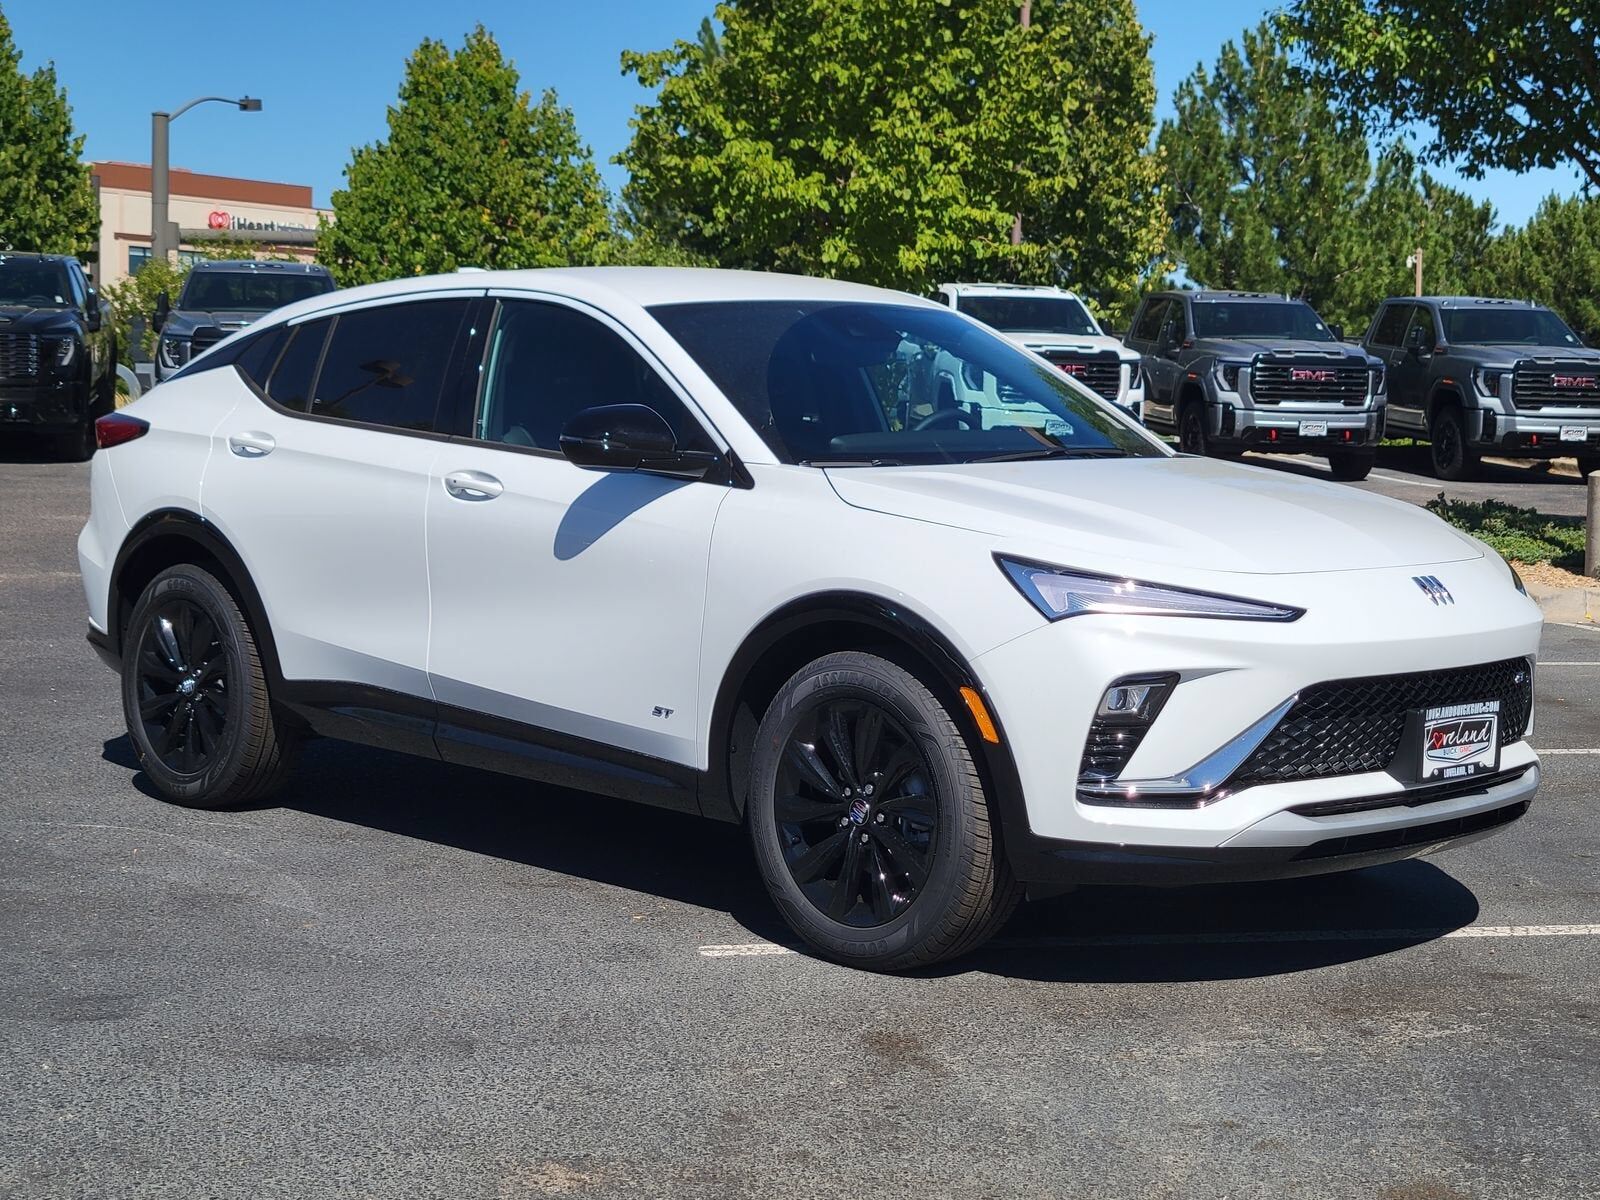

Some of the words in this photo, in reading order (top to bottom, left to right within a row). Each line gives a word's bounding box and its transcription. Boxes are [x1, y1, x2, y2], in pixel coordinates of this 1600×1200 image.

[1292, 369, 1337, 381] GMC
[1553, 375, 1597, 388] GMC
[652, 705, 674, 719] ST
